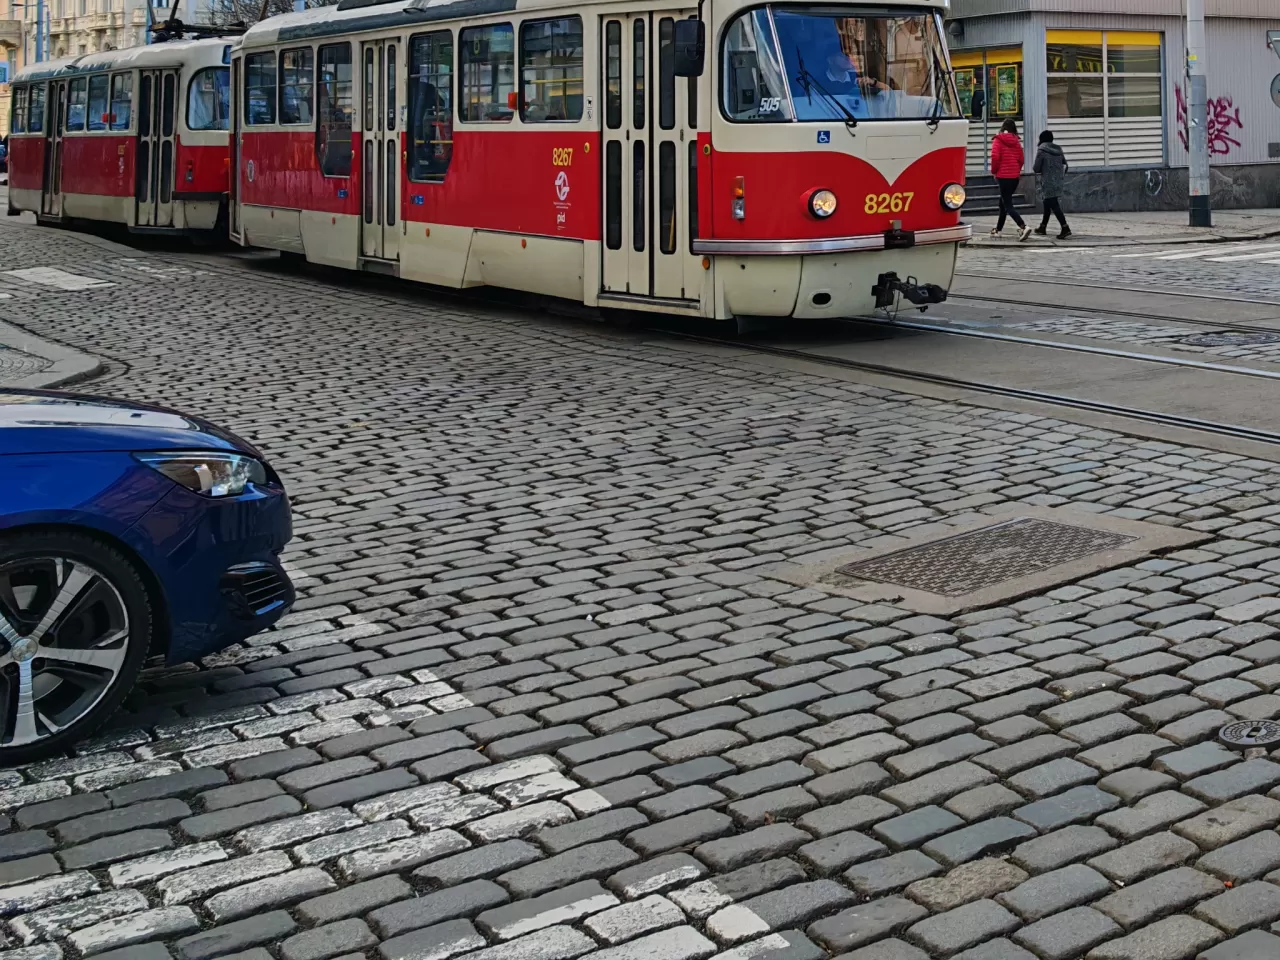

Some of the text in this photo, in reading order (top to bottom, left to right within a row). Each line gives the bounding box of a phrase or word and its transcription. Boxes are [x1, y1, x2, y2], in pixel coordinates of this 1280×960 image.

[759, 97, 781, 113] 505
[552, 147, 574, 167] 8267
[864, 192, 915, 215] 8267
